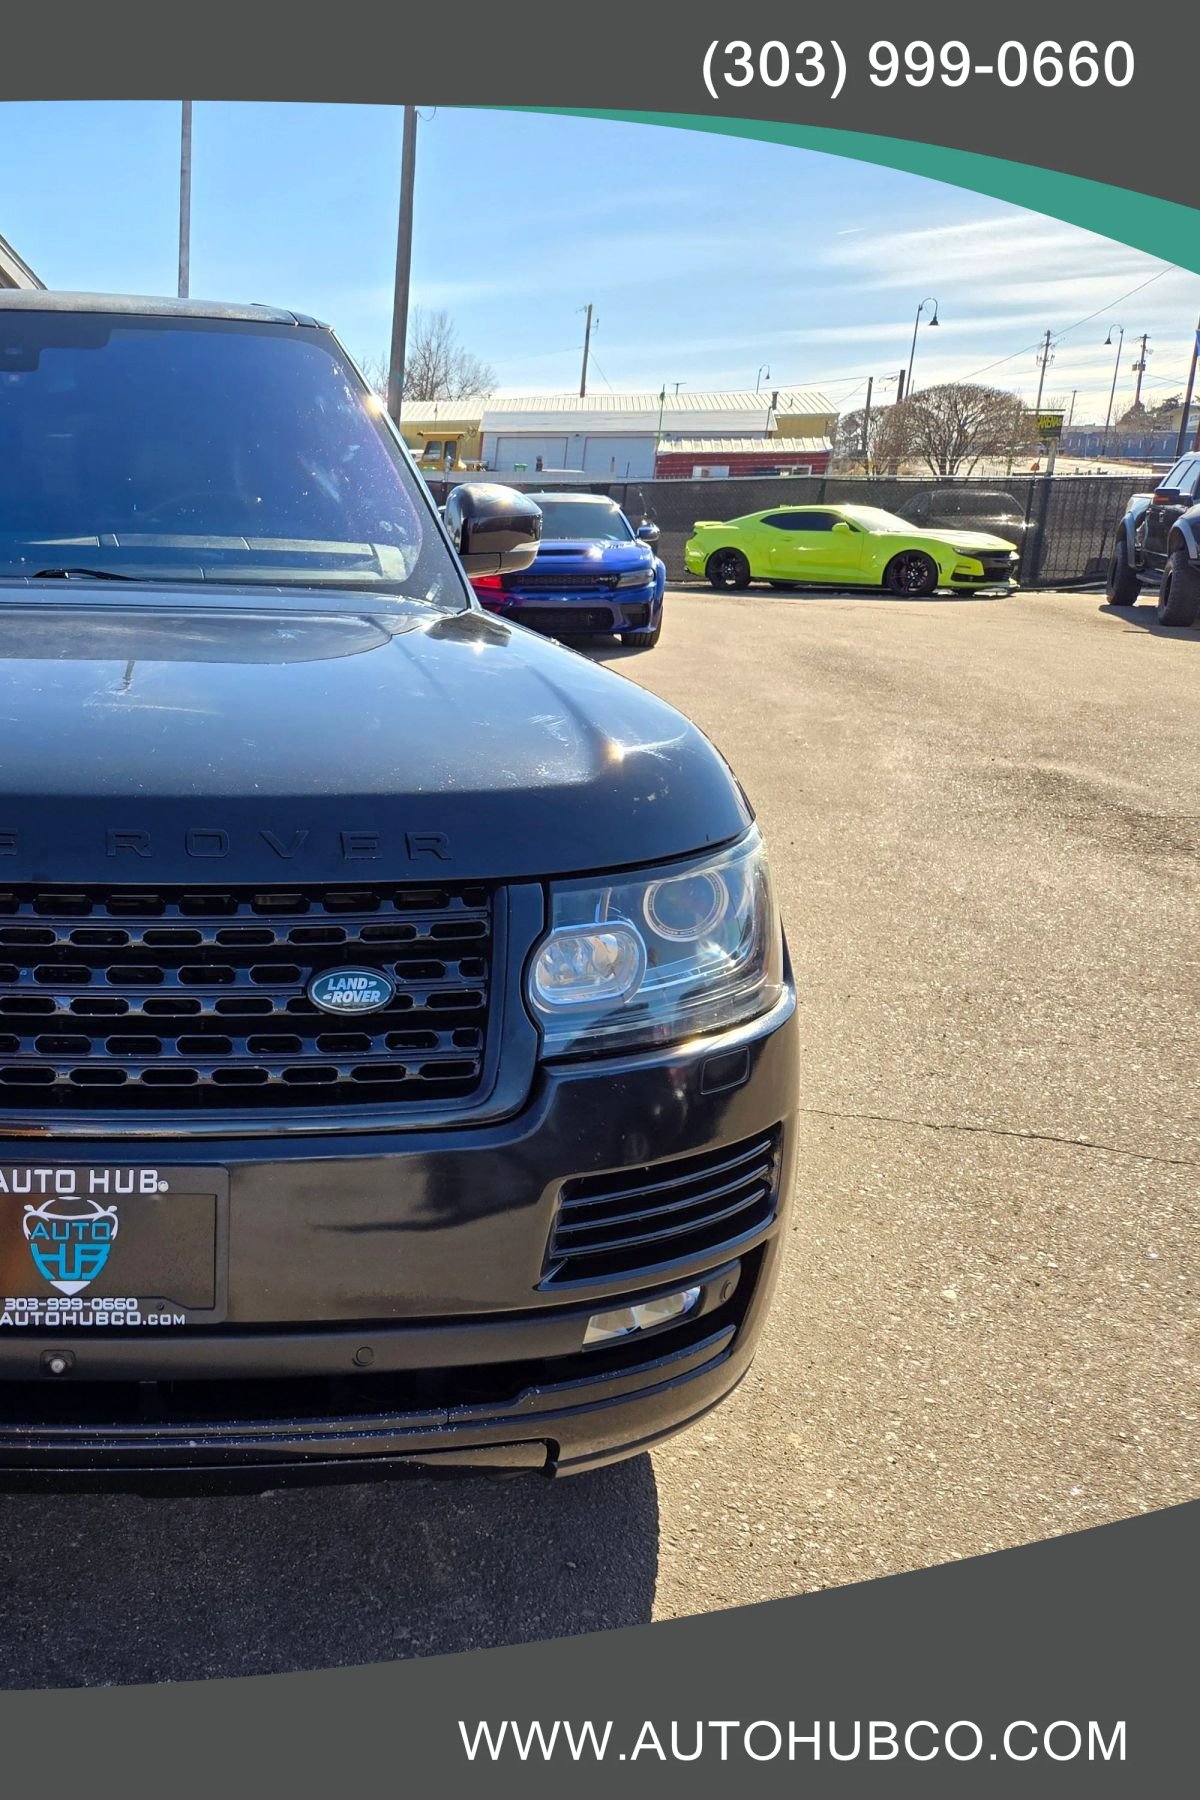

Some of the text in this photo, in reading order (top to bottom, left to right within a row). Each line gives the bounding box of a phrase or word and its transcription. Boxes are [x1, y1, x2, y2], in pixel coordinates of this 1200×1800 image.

[104, 827, 453, 861] ROVER
[327, 977, 368, 991] LAND
[331, 990, 381, 1003] ROVER
[89, 1169, 158, 1194] HUB
[30, 1221, 111, 1241] AUTO
[30, 1243, 112, 1280] HUB
[4, 1297, 138, 1311] 303-999-0660
